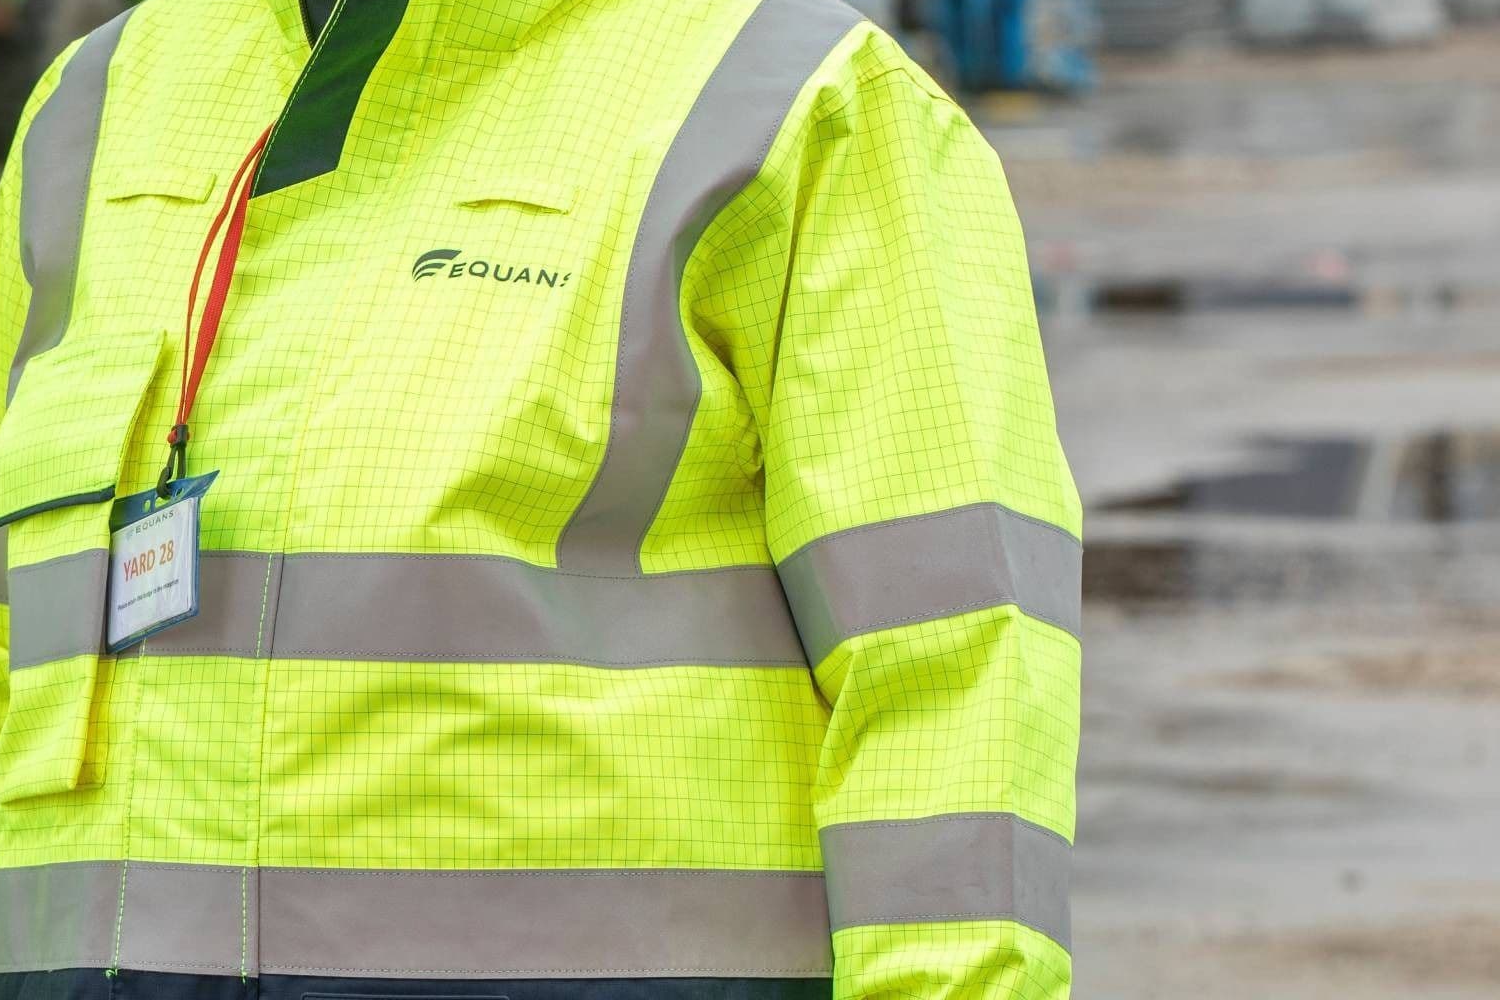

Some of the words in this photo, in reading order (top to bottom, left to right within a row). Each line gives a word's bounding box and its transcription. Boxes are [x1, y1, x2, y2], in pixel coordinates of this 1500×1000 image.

[135, 510, 174, 533] EQUANS
[124, 548, 156, 583] YARD
[159, 540, 174, 565] 28
